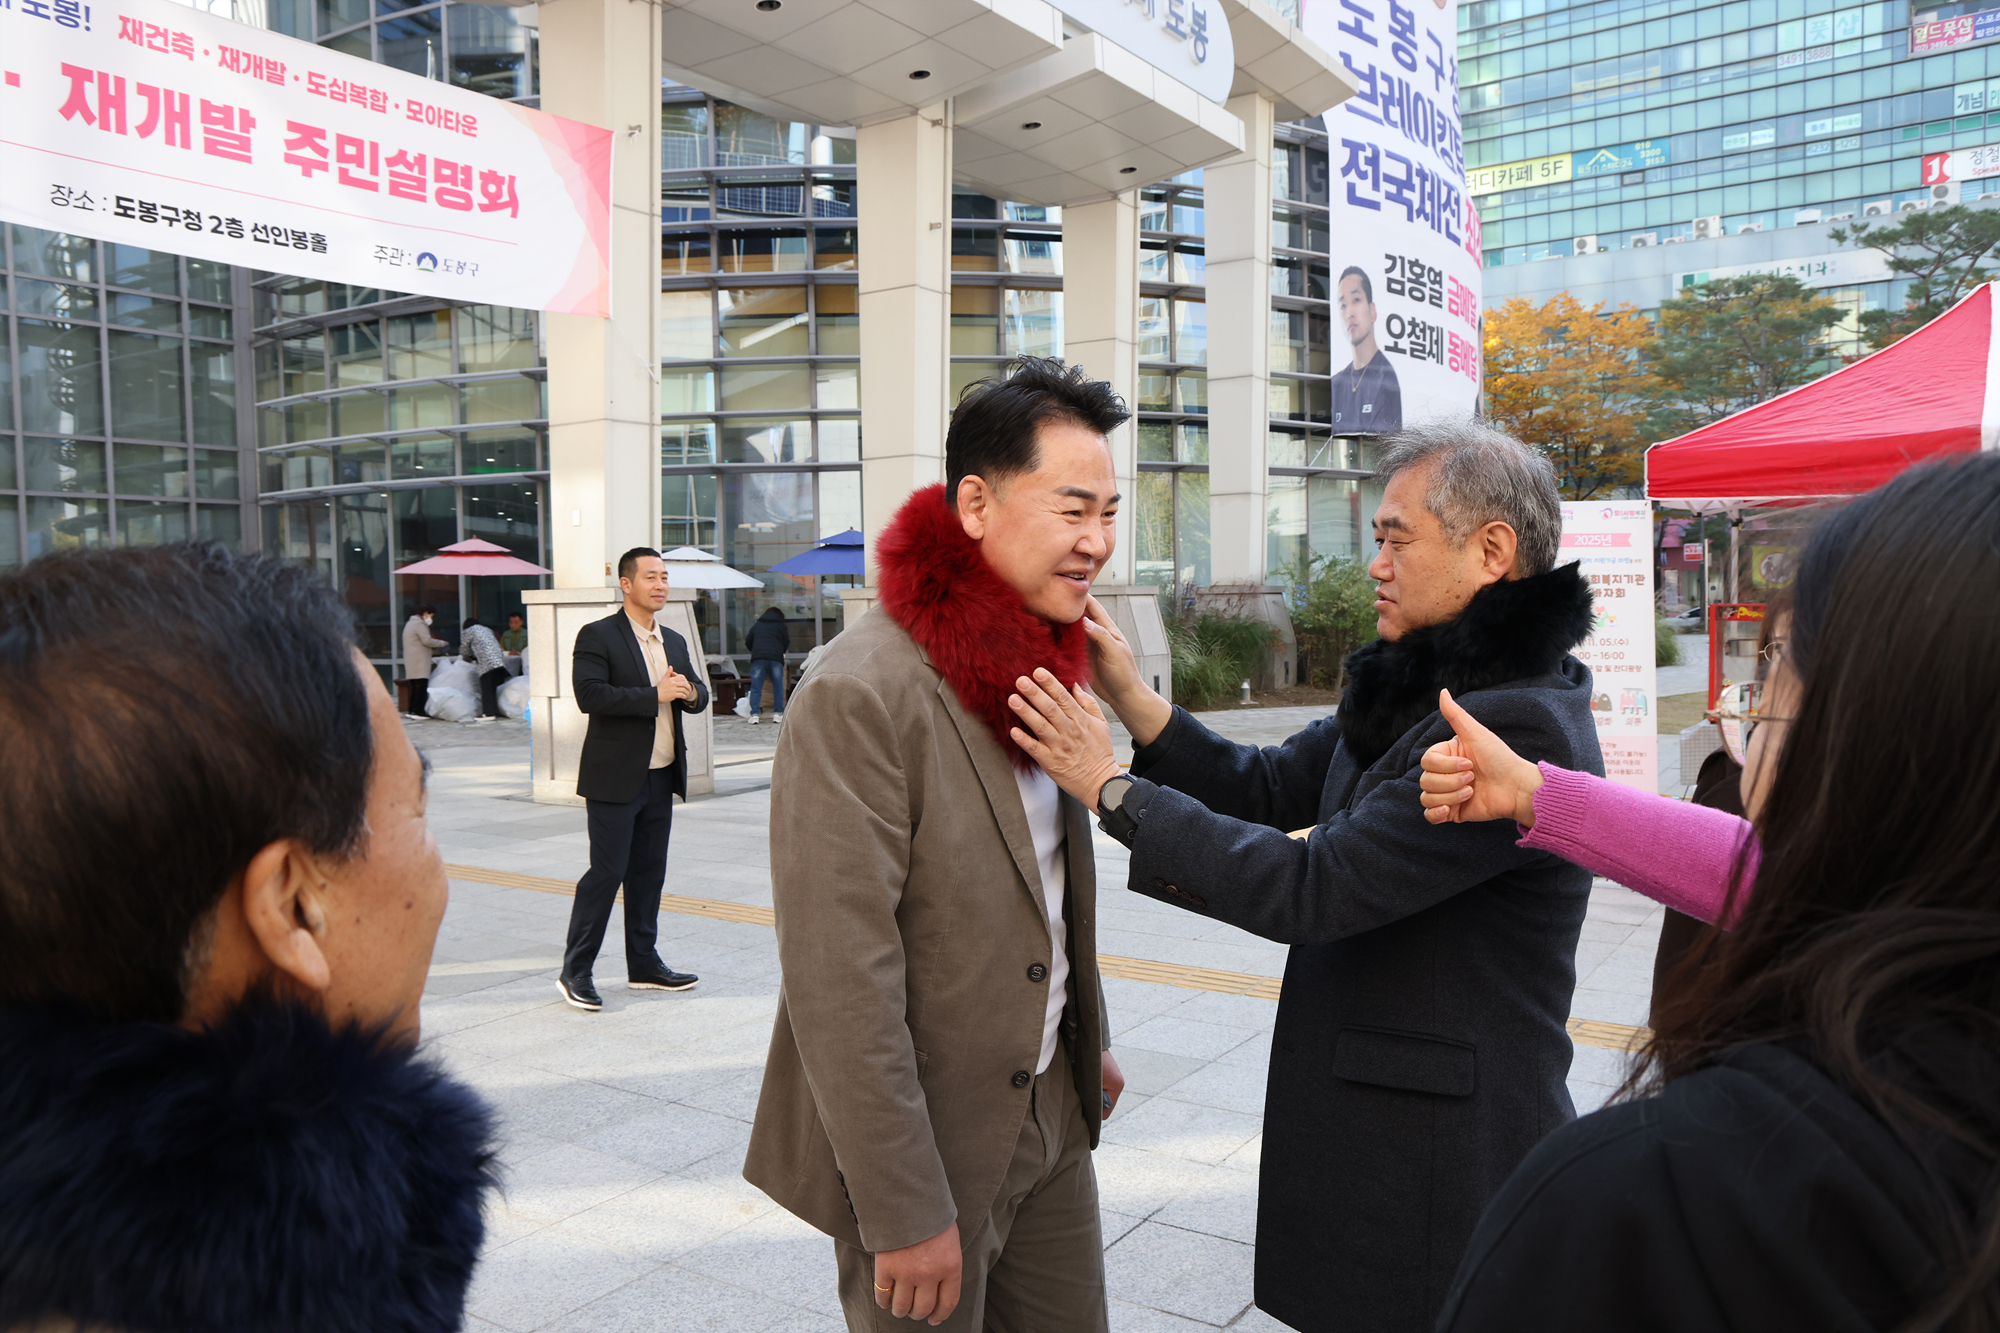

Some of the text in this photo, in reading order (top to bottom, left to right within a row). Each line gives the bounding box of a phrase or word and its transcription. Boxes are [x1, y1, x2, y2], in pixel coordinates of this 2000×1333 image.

[1914, 17, 1973, 44] 월드풋샵
[1779, 52, 1803, 66] 3491
[1806, 46, 1832, 60] 3888
[118, 14, 478, 138] 재건축 재개발 도심복합 모아타운
[1957, 91, 1984, 111] 개념
[58, 61, 520, 219] 재개발 주민설명회
[1541, 160, 1564, 178] 5F
[1340, 137, 1461, 247] 전국체전
[49, 184, 95, 211] 장소
[113, 194, 203, 231] 도봉구청
[209, 214, 246, 240] 2층
[250, 221, 329, 254] 선인봉홀
[373, 244, 405, 267] 주관
[441, 257, 481, 278] 도봉구
[1385, 253, 1477, 330] 김홍열 금메달
[1384, 313, 1477, 383] 오철제 동메달
[1574, 534, 1612, 546] 2025년
[1600, 652, 1625, 660] 16:00
